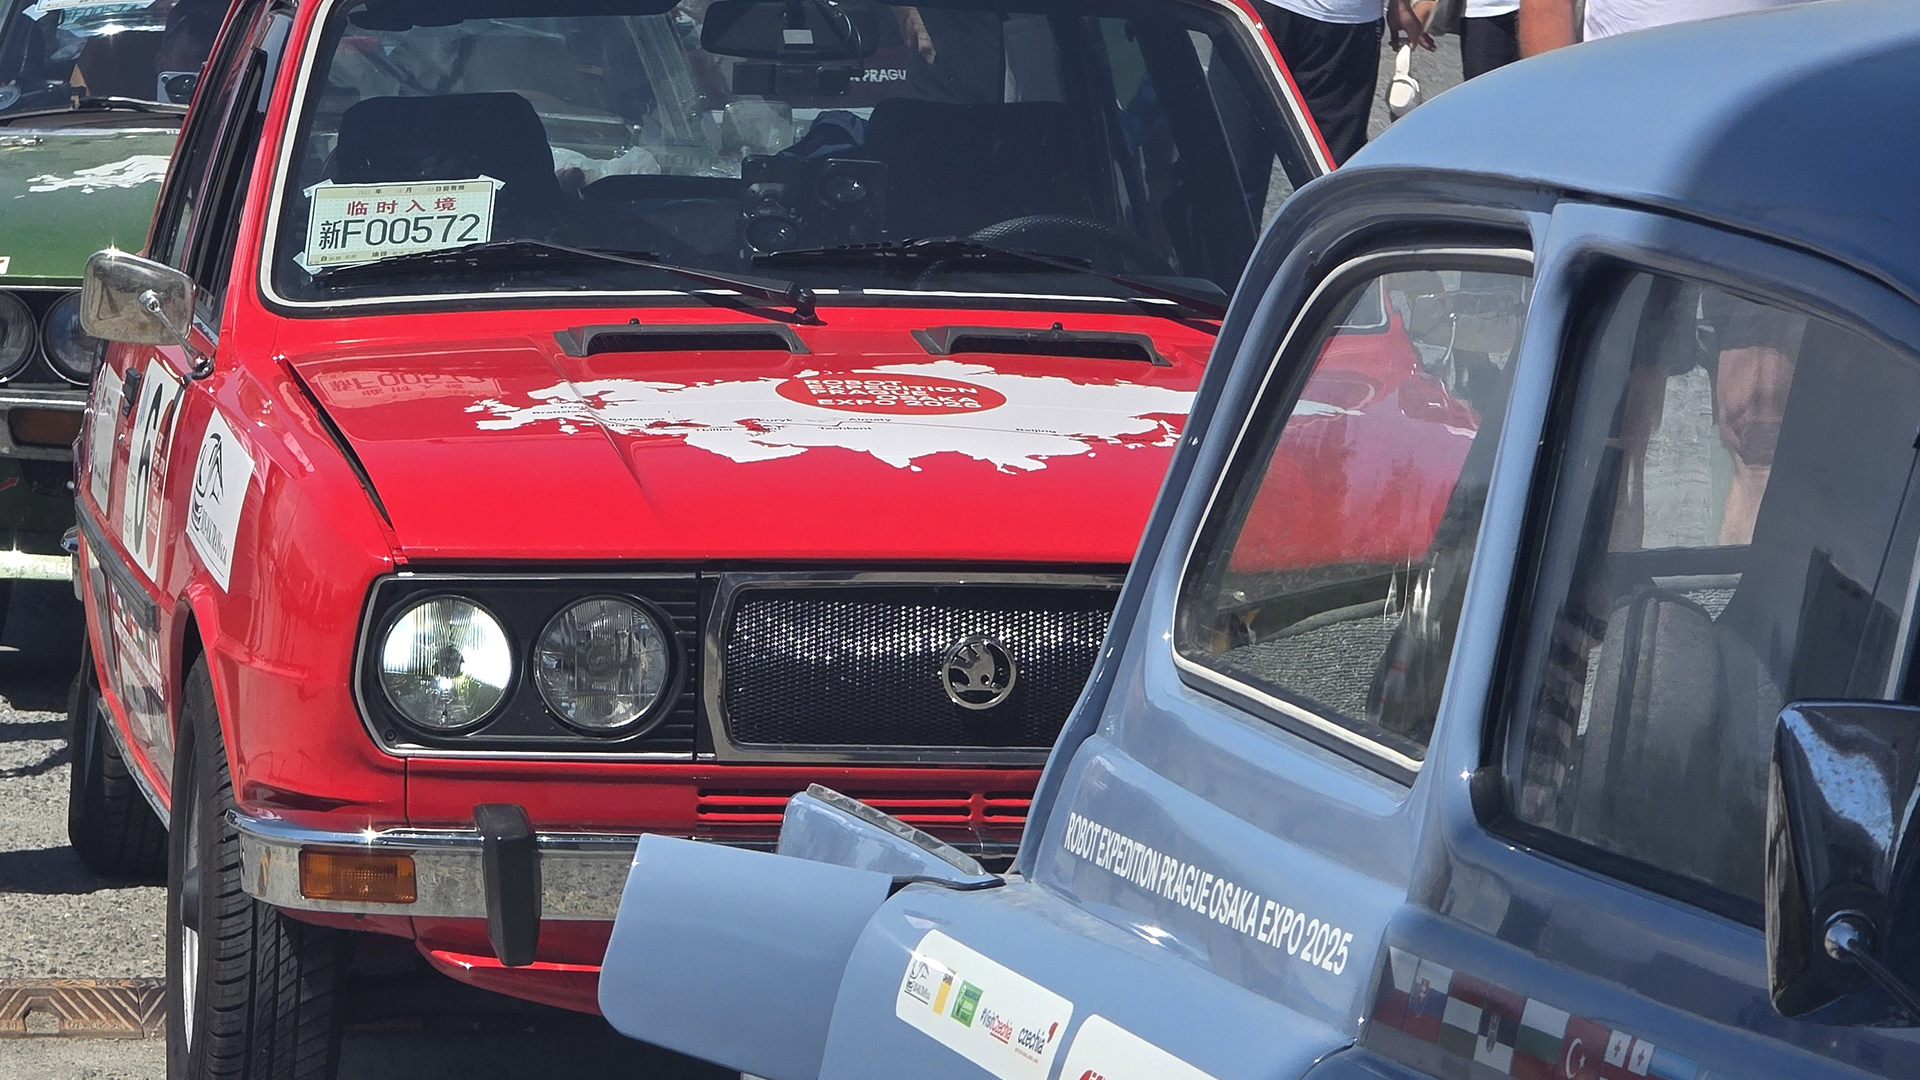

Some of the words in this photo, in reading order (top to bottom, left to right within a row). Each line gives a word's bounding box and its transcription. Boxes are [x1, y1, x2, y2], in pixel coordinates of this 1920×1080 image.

[347, 197, 456, 216] 临时入境
[319, 213, 481, 250] 新F00572
[807, 384, 977, 394] EXPEDITION
[810, 389, 928, 397] PRAGUE
[876, 395, 978, 403] OSAKA
[134, 382, 163, 555] 6
[1064, 812, 1102, 862] ROBOT
[1095, 827, 1162, 892] EXPEDITION
[1156, 855, 1214, 914] PRAGUE
[1208, 878, 1261, 937] OSAKA
[1257, 899, 1306, 956] EXPO
[1300, 918, 1354, 976] 2025
[1017, 1028, 1046, 1055] czechia
